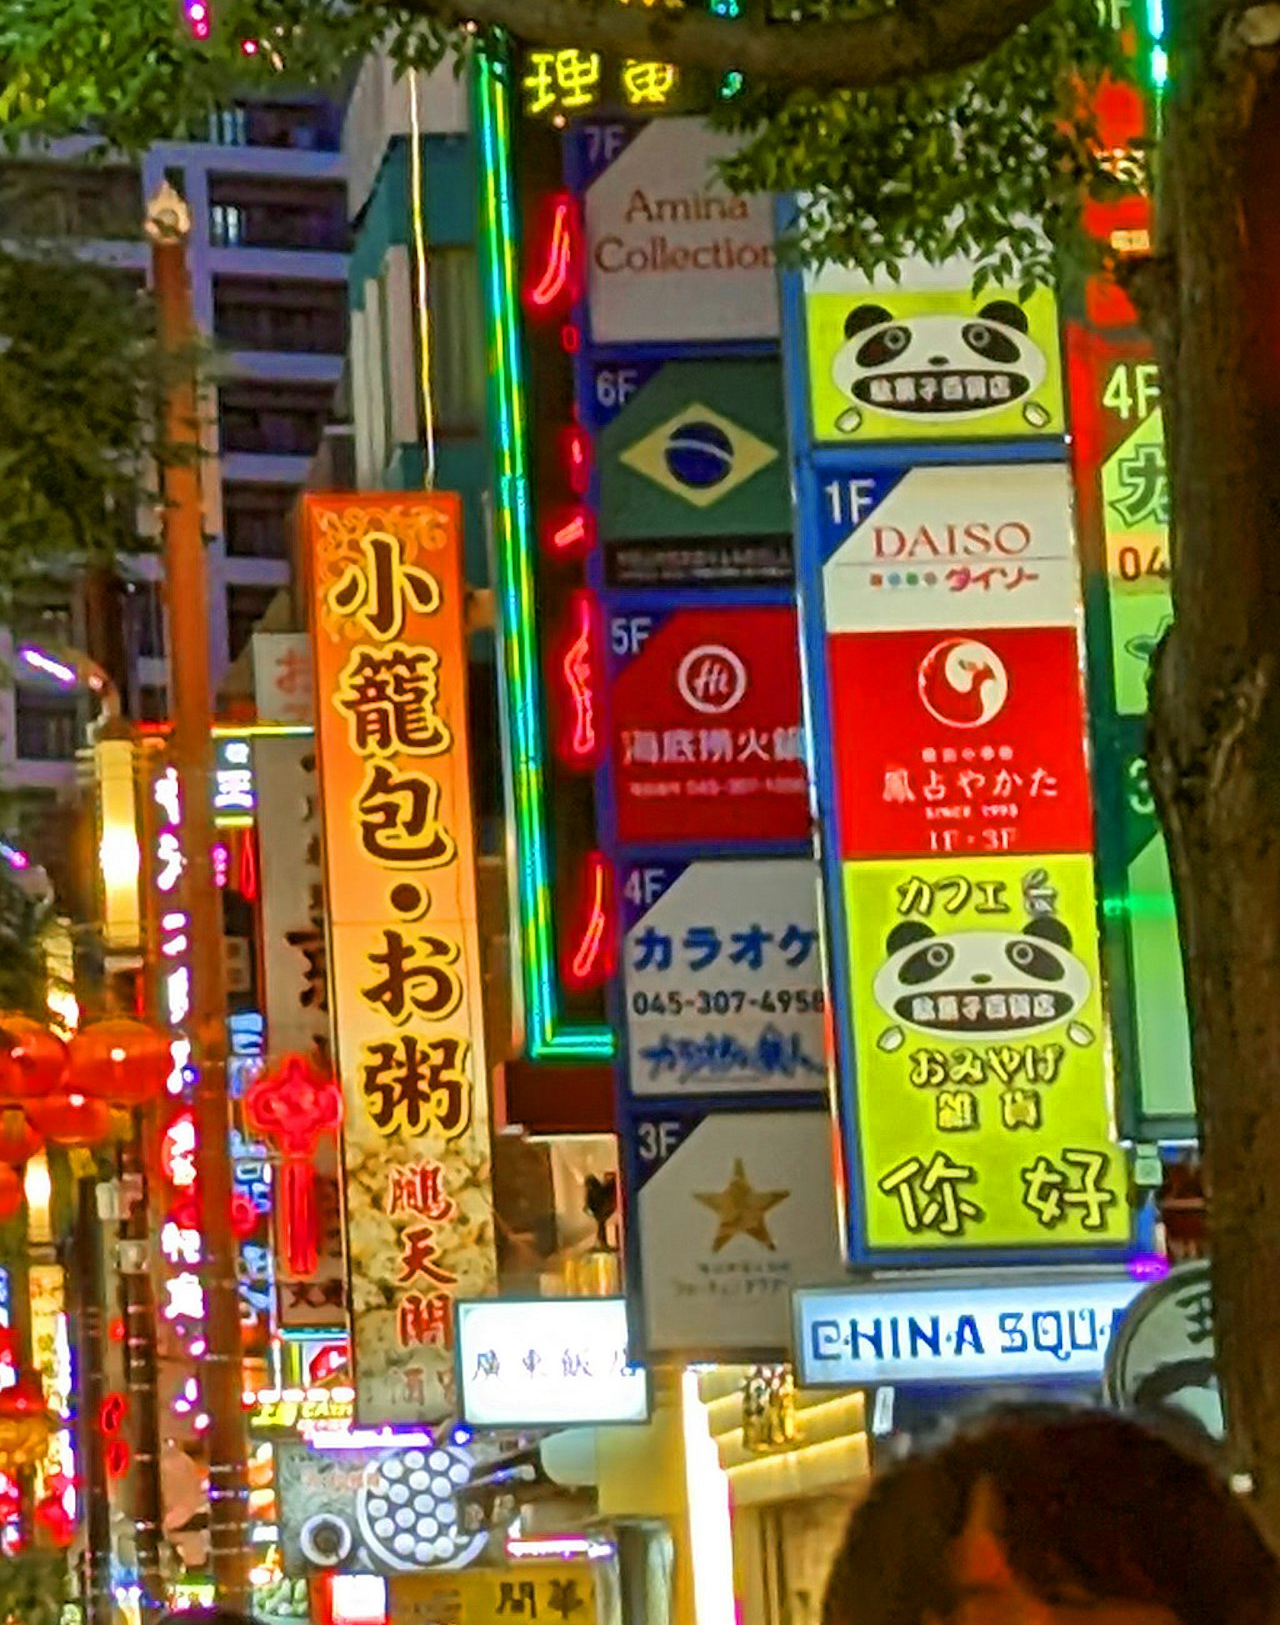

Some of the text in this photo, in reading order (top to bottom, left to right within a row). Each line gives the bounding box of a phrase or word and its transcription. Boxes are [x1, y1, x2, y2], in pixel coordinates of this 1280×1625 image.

[584, 124, 625, 164] 7F
[625, 186, 750, 225] Amina
[596, 368, 639, 407] 6F
[1102, 364, 1162, 420] 4F
[824, 477, 877, 525] 1F
[872, 521, 1032, 559] DAISO
[945, 565, 1041, 593] ダイソー
[610, 615, 653, 656] 5F
[328, 532, 472, 1136] 小籠包・お粥
[623, 868, 666, 907] 4F
[895, 873, 1012, 917] カフェ
[632, 923, 819, 972] カラオケ
[909, 1043, 1064, 1088] おみやげ
[637, 1121, 680, 1160] 3F
[878, 1148, 1117, 1236] 你好
[811, 1313, 985, 1361] CHINA
